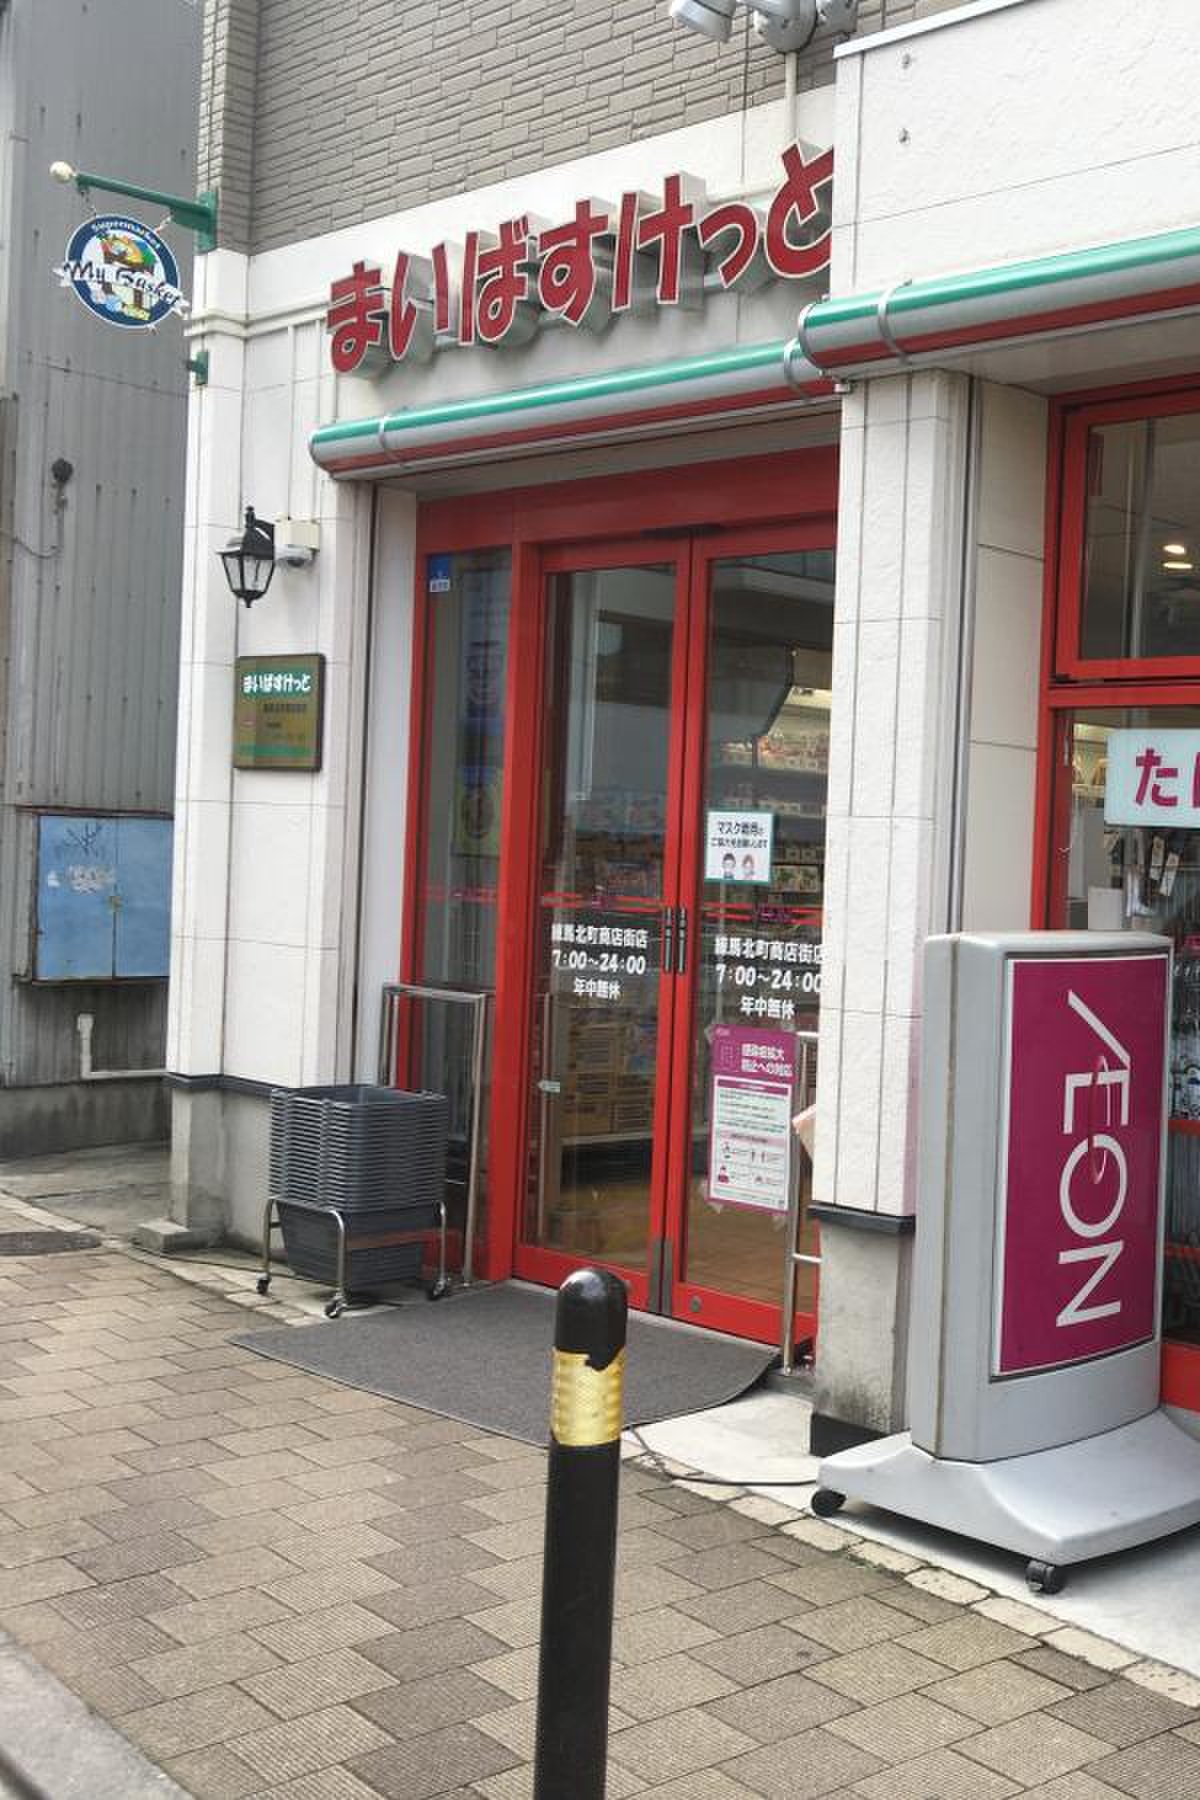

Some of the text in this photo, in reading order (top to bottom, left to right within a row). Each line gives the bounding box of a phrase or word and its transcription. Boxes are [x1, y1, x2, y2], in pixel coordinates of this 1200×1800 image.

[327, 143, 834, 373] まいばすけっと
[63, 260, 106, 285] My
[243, 673, 312, 693] まいばすけっと
[573, 977, 621, 999] 年中無休
[740, 996, 795, 1020] 年中無休
